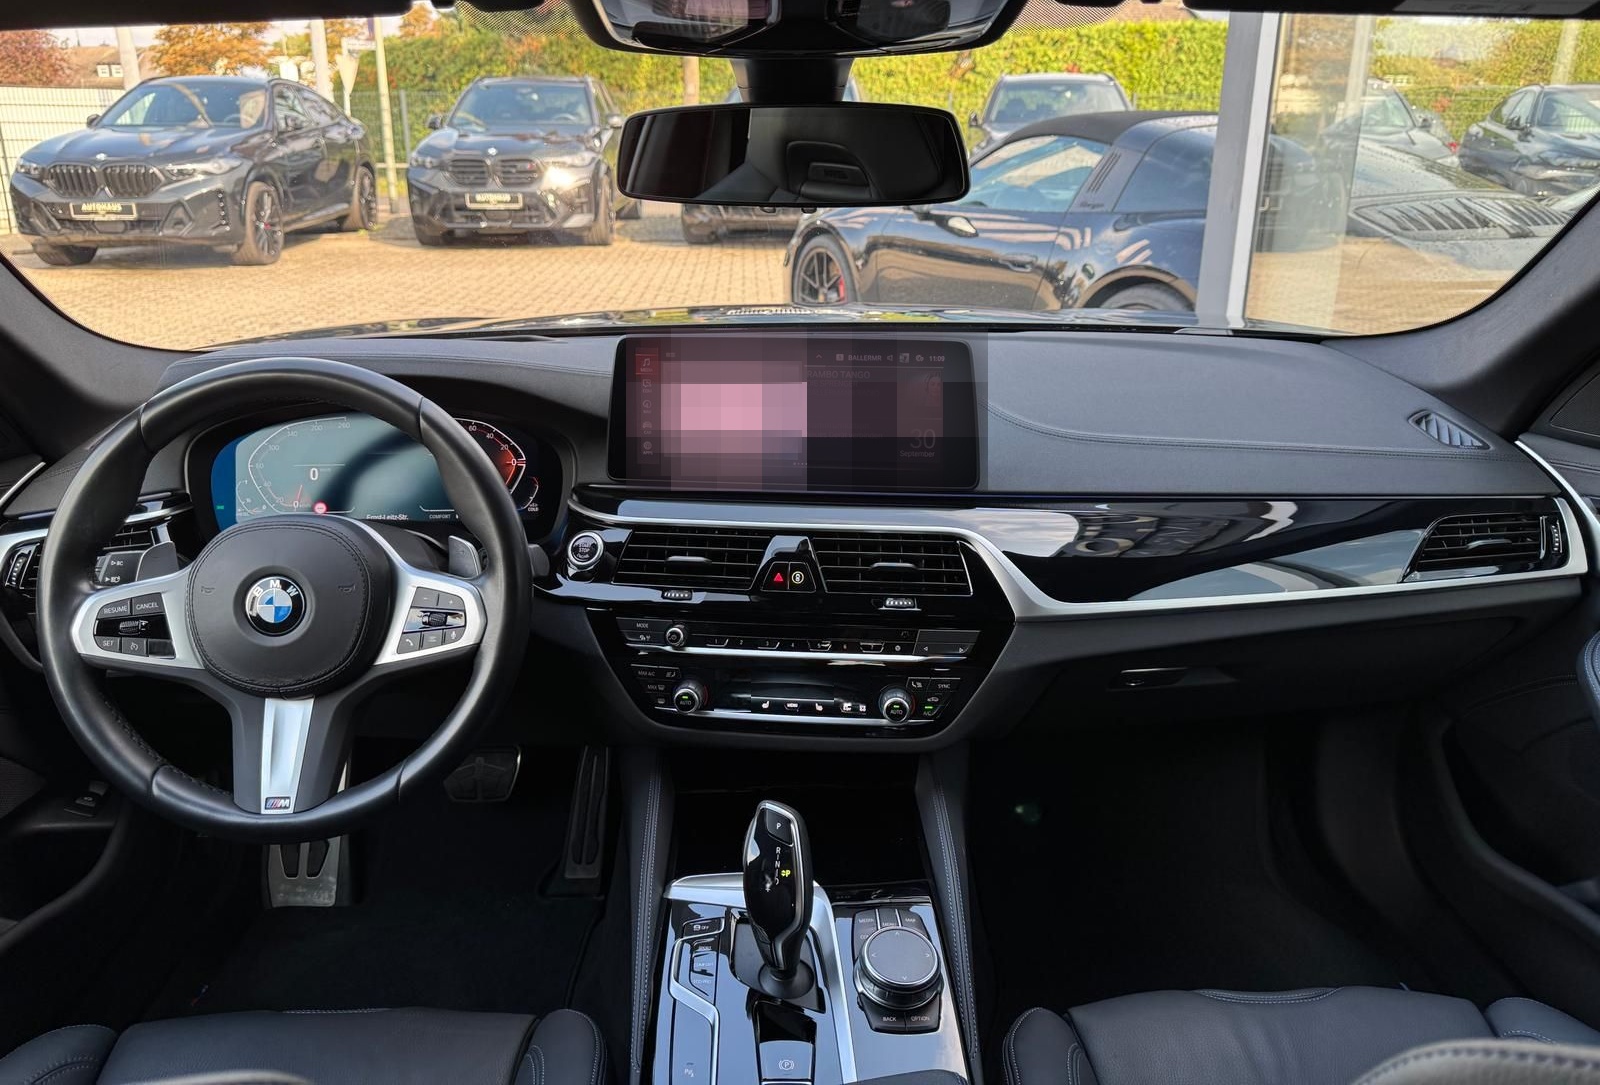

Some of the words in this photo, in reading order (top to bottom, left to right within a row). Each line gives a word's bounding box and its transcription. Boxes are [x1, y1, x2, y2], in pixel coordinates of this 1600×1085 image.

[81, 202, 122, 212] AUTOHAUS
[807, 370, 838, 379] RAMBO
[839, 370, 870, 380] TANGO
[486, 432, 494, 440] 40
[910, 428, 936, 449] 30
[899, 450, 936, 459] September
[511, 458, 517, 466] 0
[309, 467, 319, 481] 0
[292, 500, 299, 508] 0
[252, 579, 299, 598] BMW
[103, 605, 128, 614] RESUME
[136, 602, 159, 611] CANCEL
[776, 822, 782, 830] P
[775, 846, 781, 855] R
[775, 861, 780, 869] N
[785, 869, 791, 878] P
